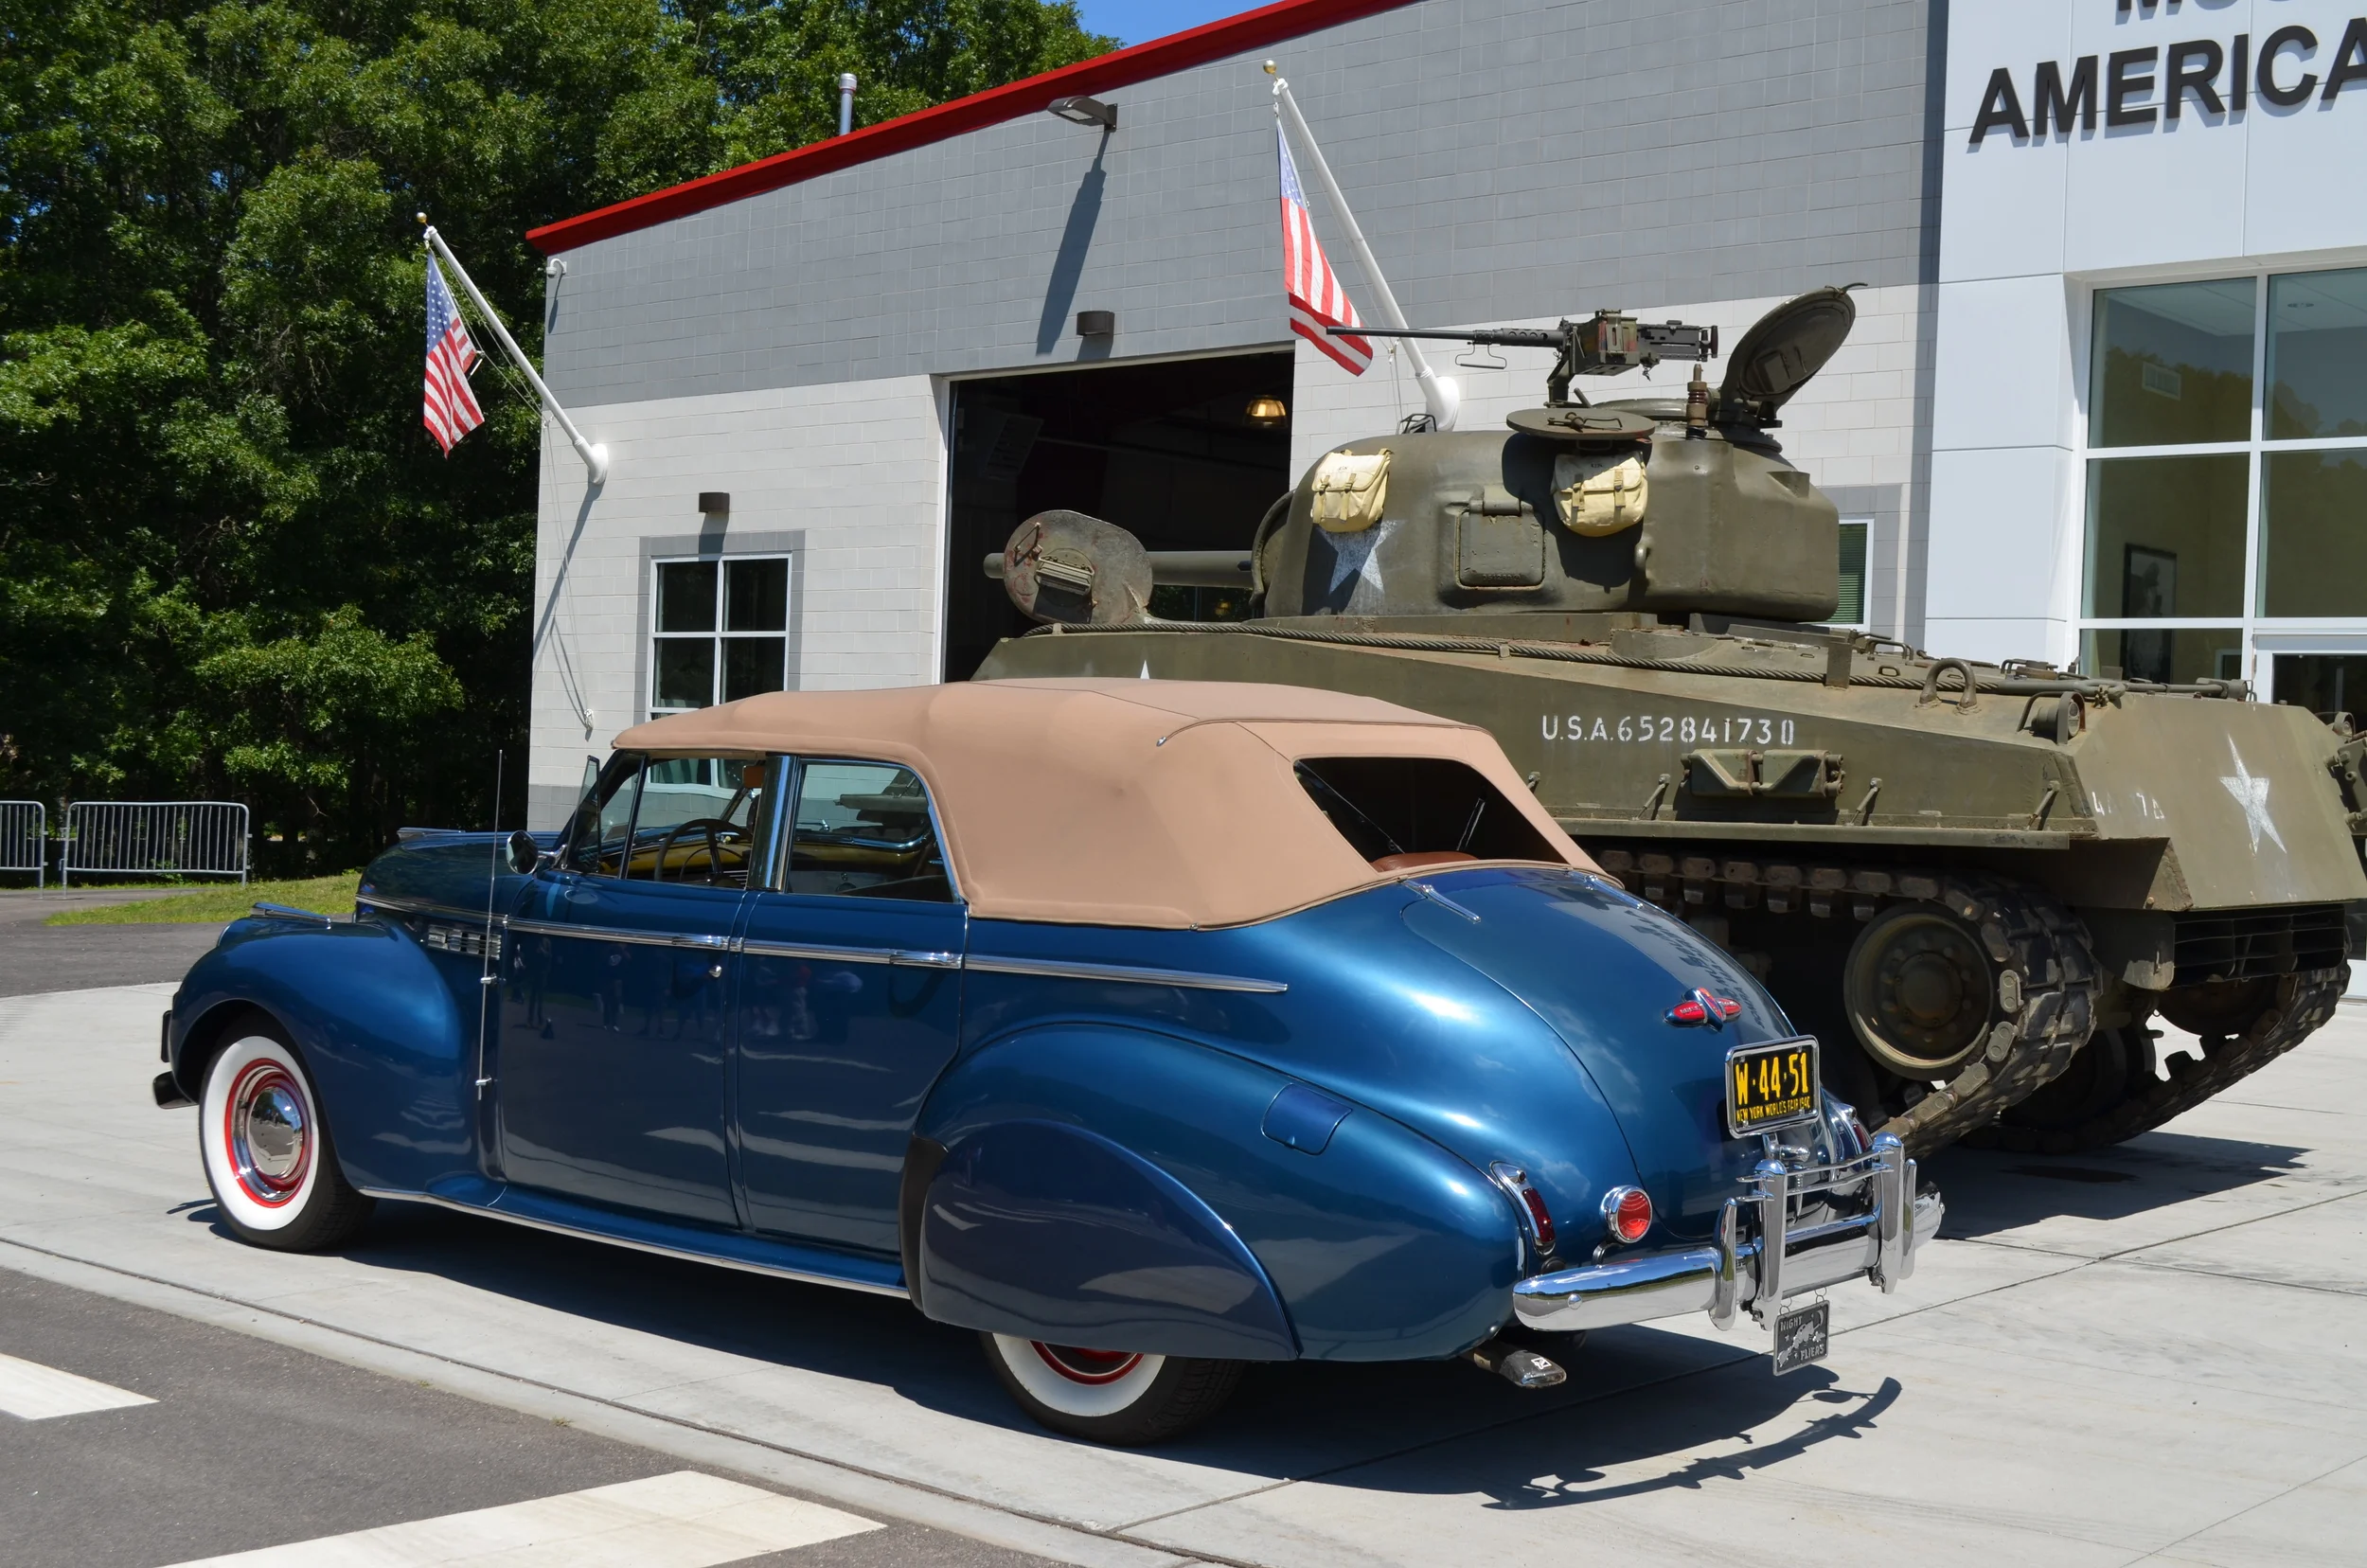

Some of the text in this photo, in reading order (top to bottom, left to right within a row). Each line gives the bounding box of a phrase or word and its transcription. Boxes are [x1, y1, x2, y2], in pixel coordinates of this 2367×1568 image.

[1968, 17, 2367, 144] AMERICA
[1736, 1108, 1749, 1122] NEW
[1749, 1105, 1765, 1120] YORK
[1765, 1100, 1788, 1116] WORLD'S
[1788, 1098, 1799, 1113] FAIR
[1781, 1316, 1803, 1331] NIGHT
[1801, 1345, 1824, 1361] FLIERS
